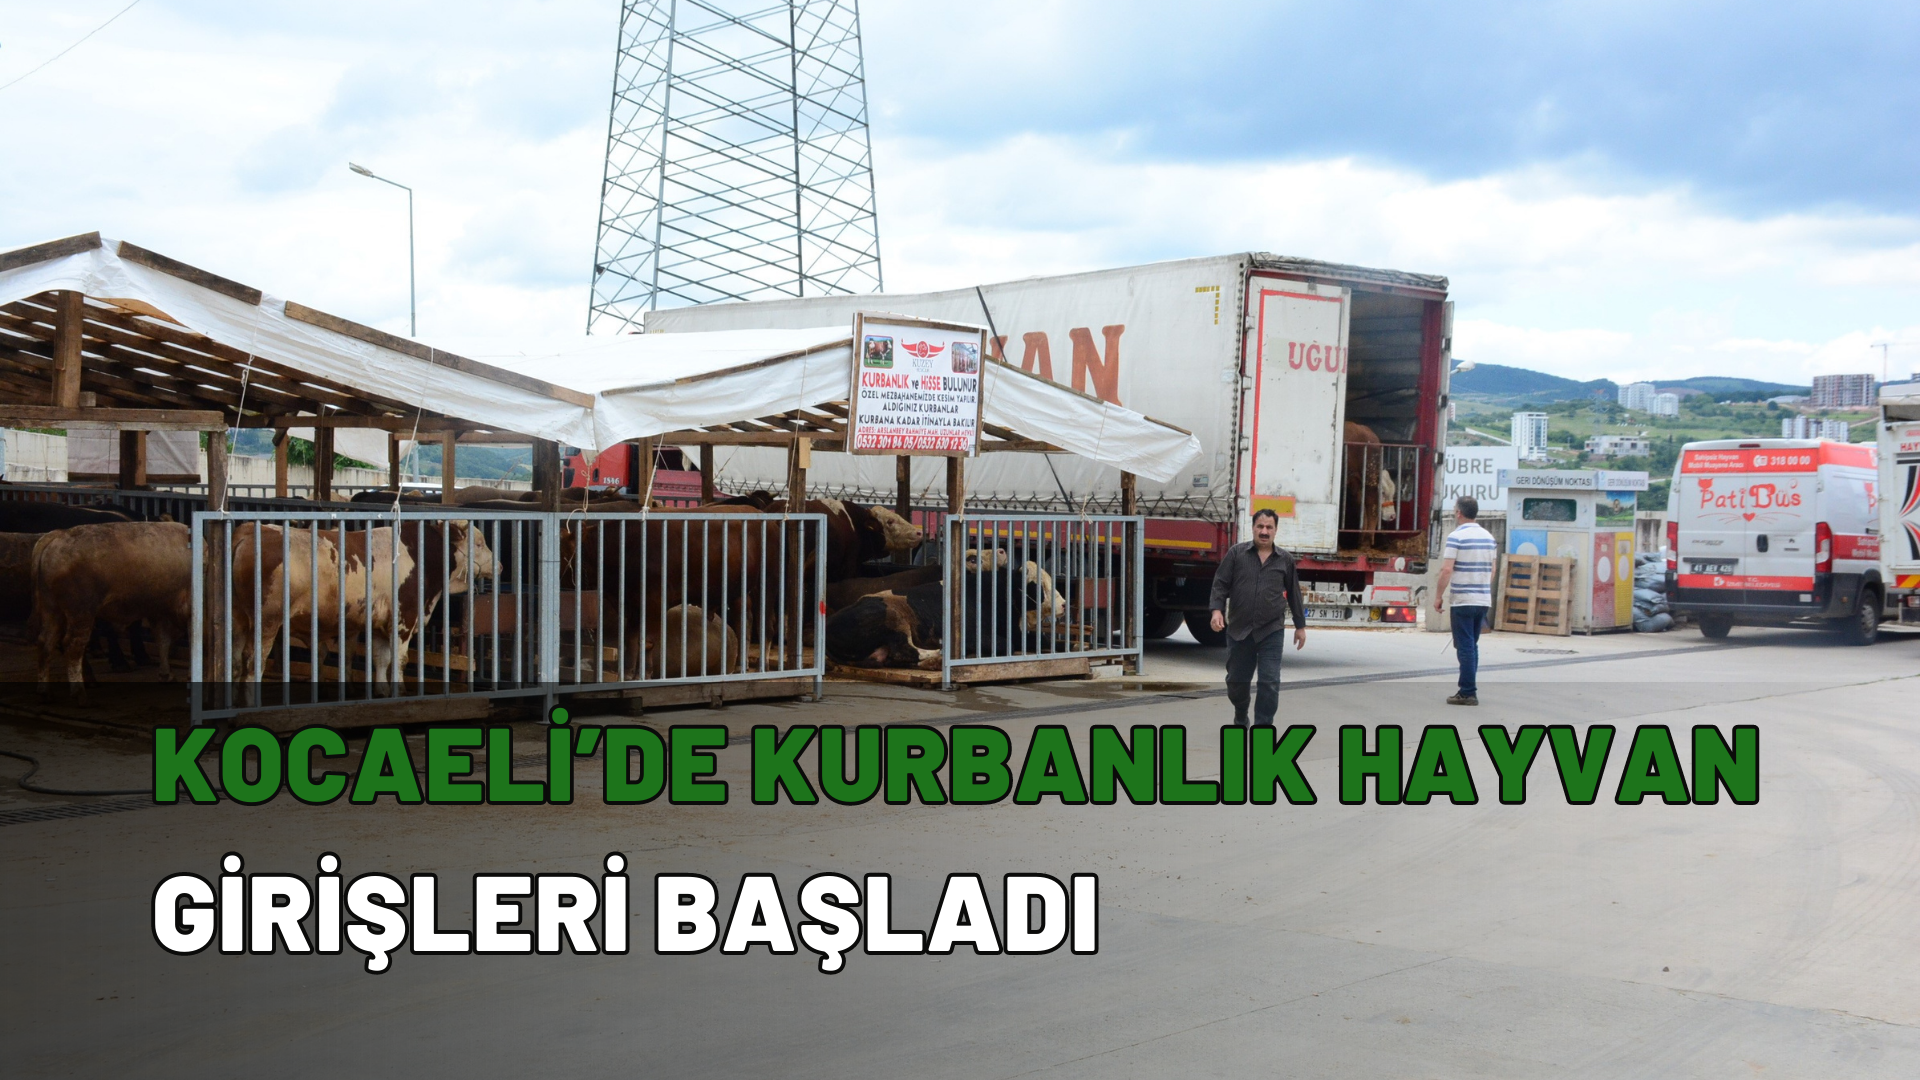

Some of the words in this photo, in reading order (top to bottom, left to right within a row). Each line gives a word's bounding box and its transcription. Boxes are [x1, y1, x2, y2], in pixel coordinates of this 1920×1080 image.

[912, 358, 934, 369] KUZEY
[862, 372, 910, 389] KURBANLIK
[911, 379, 920, 390] ve
[942, 376, 977, 393] BULUNUR
[861, 387, 879, 399] ÖZEL
[880, 389, 936, 402] MEZBAHANEMİZDE
[937, 391, 955, 403] KESİM
[882, 400, 918, 413] ALDIĞINIZ
[918, 402, 959, 414] KURBANLAR
[858, 414, 895, 425] KURBANA
[896, 415, 920, 426] KADAR
[921, 415, 952, 427] İTİNAYLA
[952, 417, 975, 428] BAKILIR
[858, 426, 876, 434] ADRES:
[857, 434, 876, 448] 0532
[877, 434, 892, 449] 301
[950, 437, 958, 450] 12
[1445, 454, 1494, 474] ÜBRE
[1770, 456, 1786, 466] 318
[1532, 475, 1563, 487] DÖNÜŞÜM
[1564, 477, 1593, 487] NOKTASI
[1443, 484, 1500, 501] UKURU
[1307, 609, 1316, 618] 27
[1319, 609, 1328, 618] SN
[1332, 609, 1343, 618] 131
